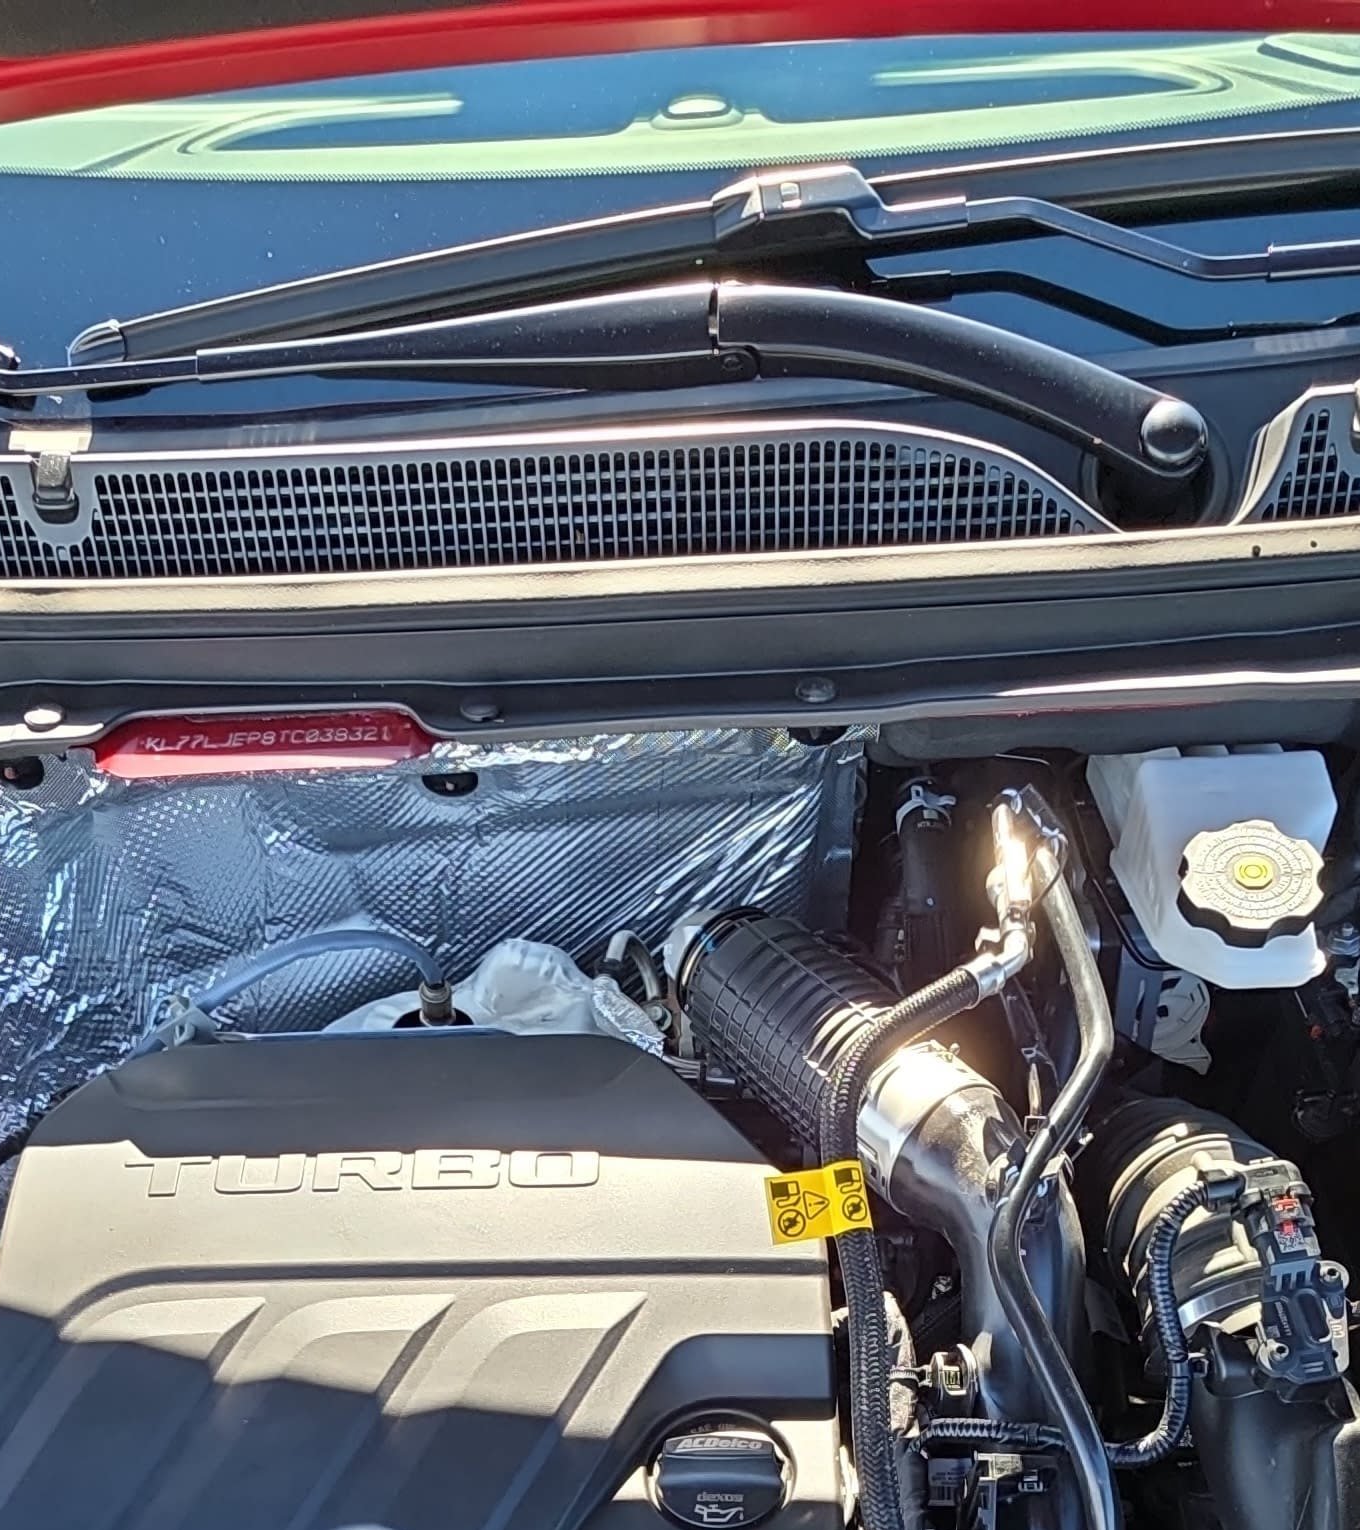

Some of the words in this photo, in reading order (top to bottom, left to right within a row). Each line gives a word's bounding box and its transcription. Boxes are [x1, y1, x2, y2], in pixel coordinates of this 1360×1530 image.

[144, 725, 391, 751] KL77LJEP8TC038321
[125, 1149, 600, 1197] TURBO
[677, 1437, 762, 1450] ACDelco
